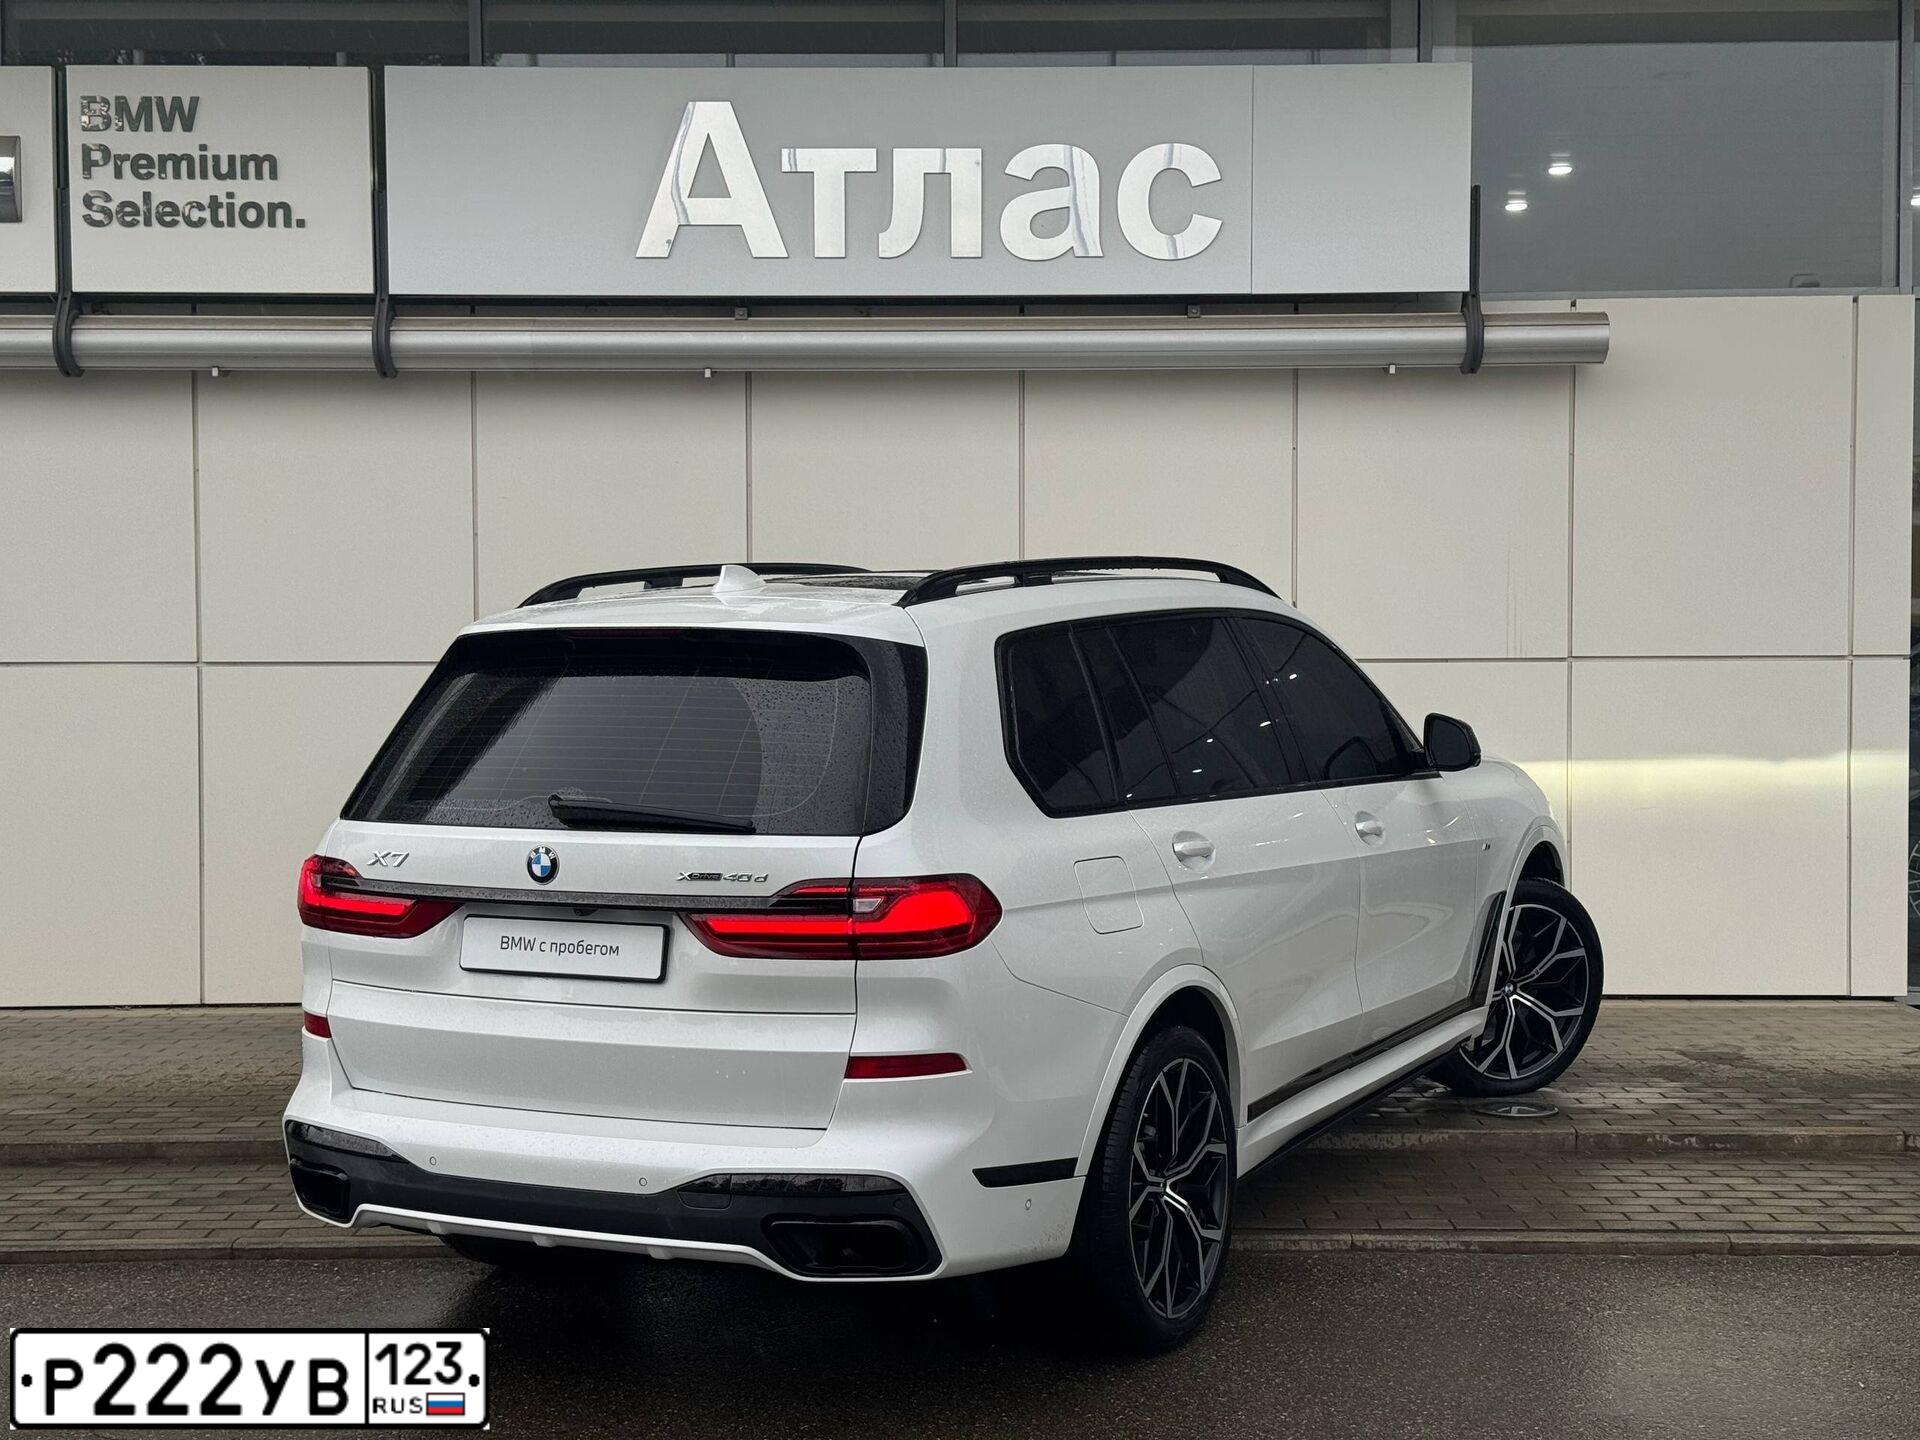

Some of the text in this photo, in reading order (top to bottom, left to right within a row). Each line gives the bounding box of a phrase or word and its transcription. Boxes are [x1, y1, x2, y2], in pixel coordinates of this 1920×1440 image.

[80, 95, 200, 133] BMW
[81, 143, 279, 181] Premium
[635, 100, 1223, 261] Атлас
[82, 190, 306, 228] Selection.
[367, 850, 410, 867] X7
[500, 935, 536, 952] BMW
[550, 940, 620, 957] пробегом
